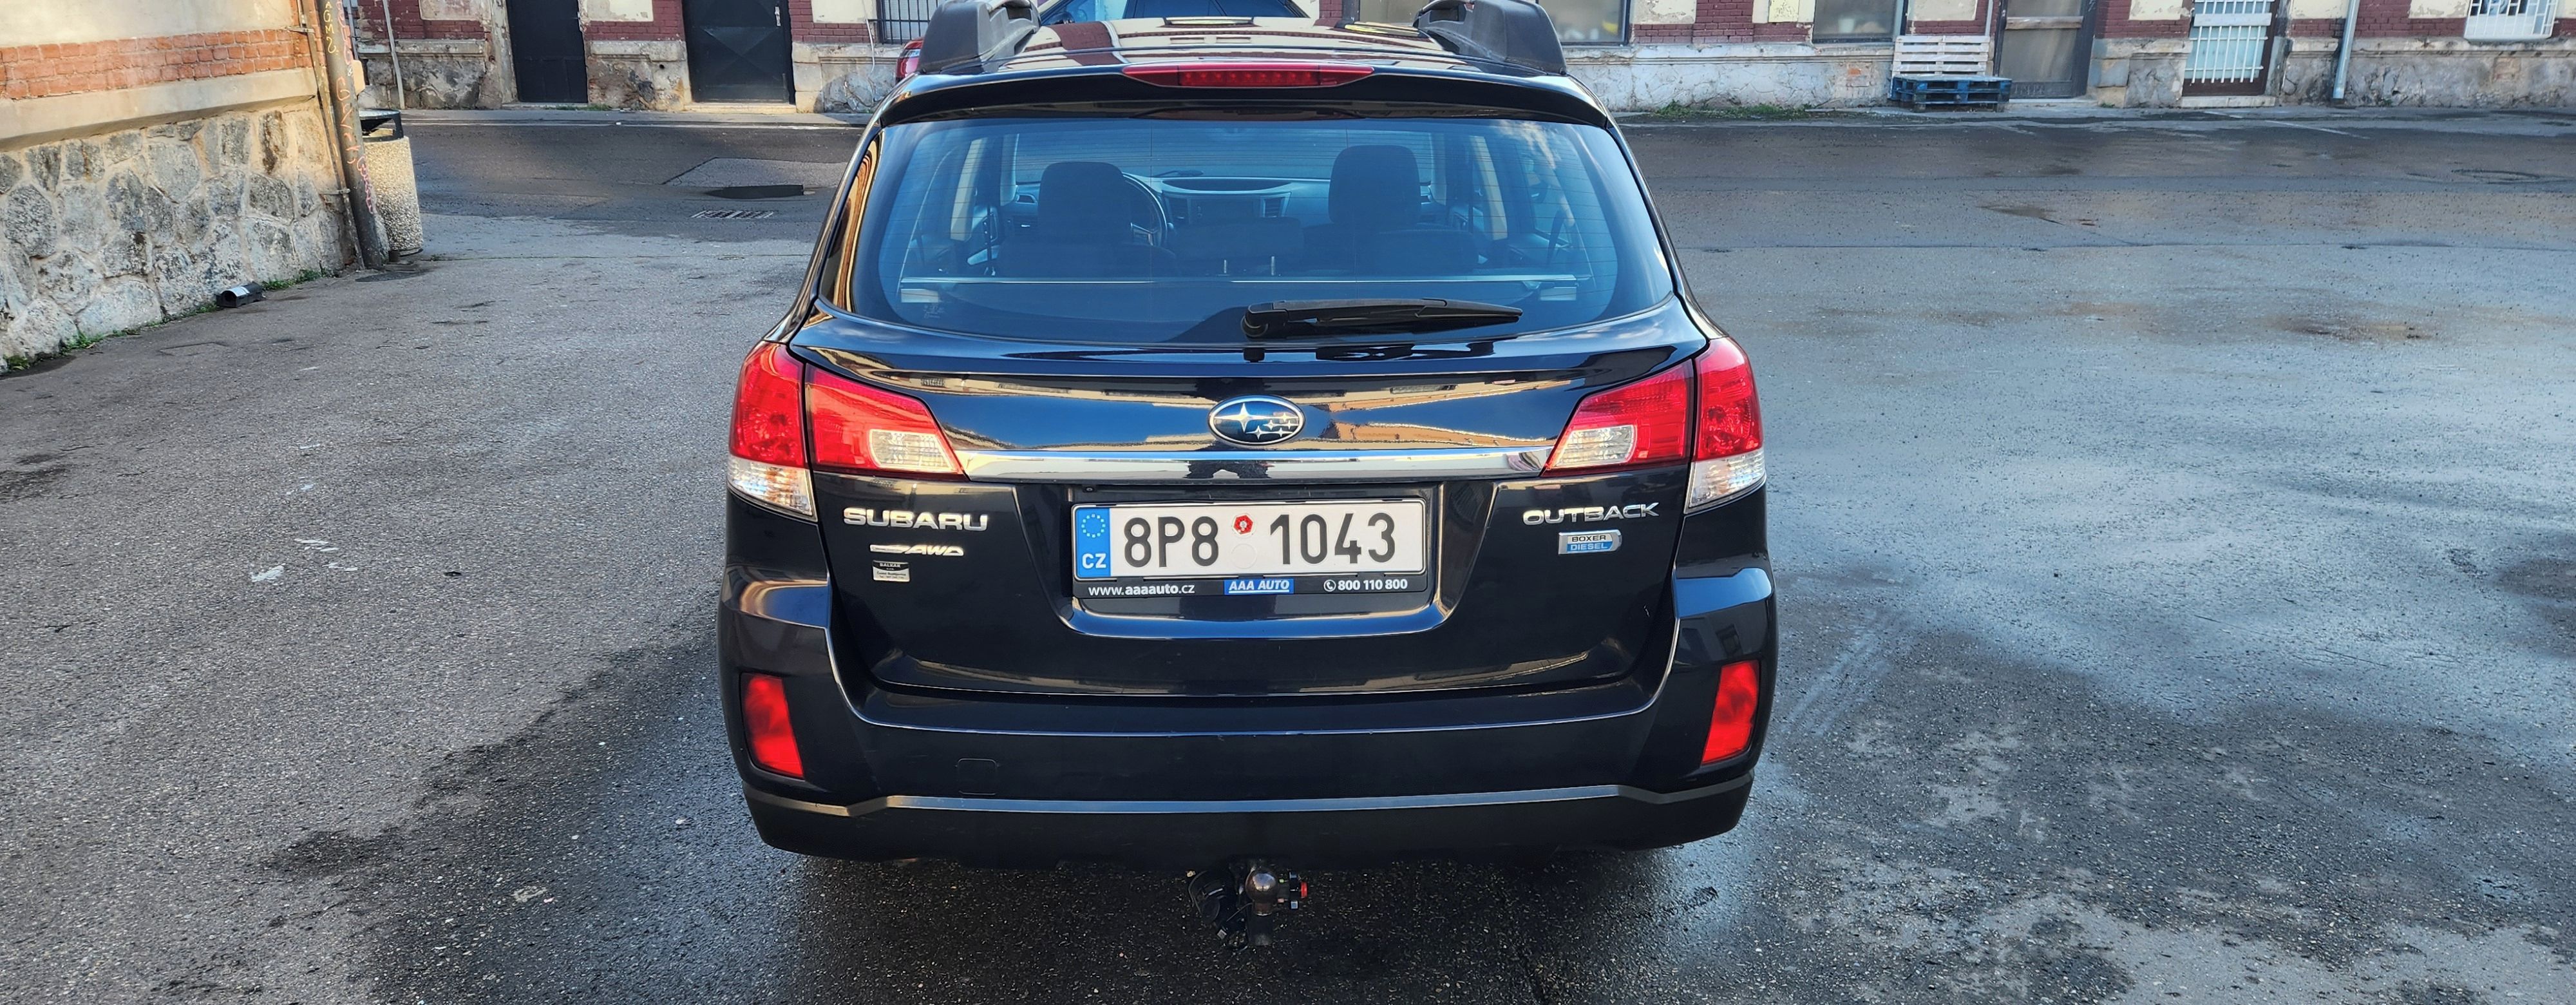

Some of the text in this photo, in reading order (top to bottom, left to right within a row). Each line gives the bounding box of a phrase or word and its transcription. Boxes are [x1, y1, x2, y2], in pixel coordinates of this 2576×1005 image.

[844, 508, 988, 531] SUBARU
[1522, 502, 1660, 526] OUTBACK
[1124, 513, 1396, 568] 8P8 1043
[1570, 542, 1608, 551] DIESEL
[905, 545, 964, 557] AWD
[1082, 553, 1106, 569] CZ
[1088, 584, 1195, 596] www.aaaauto.cz
[1229, 580, 1290, 591] AAA AUTO
[1338, 579, 1408, 591] 800 110 800
